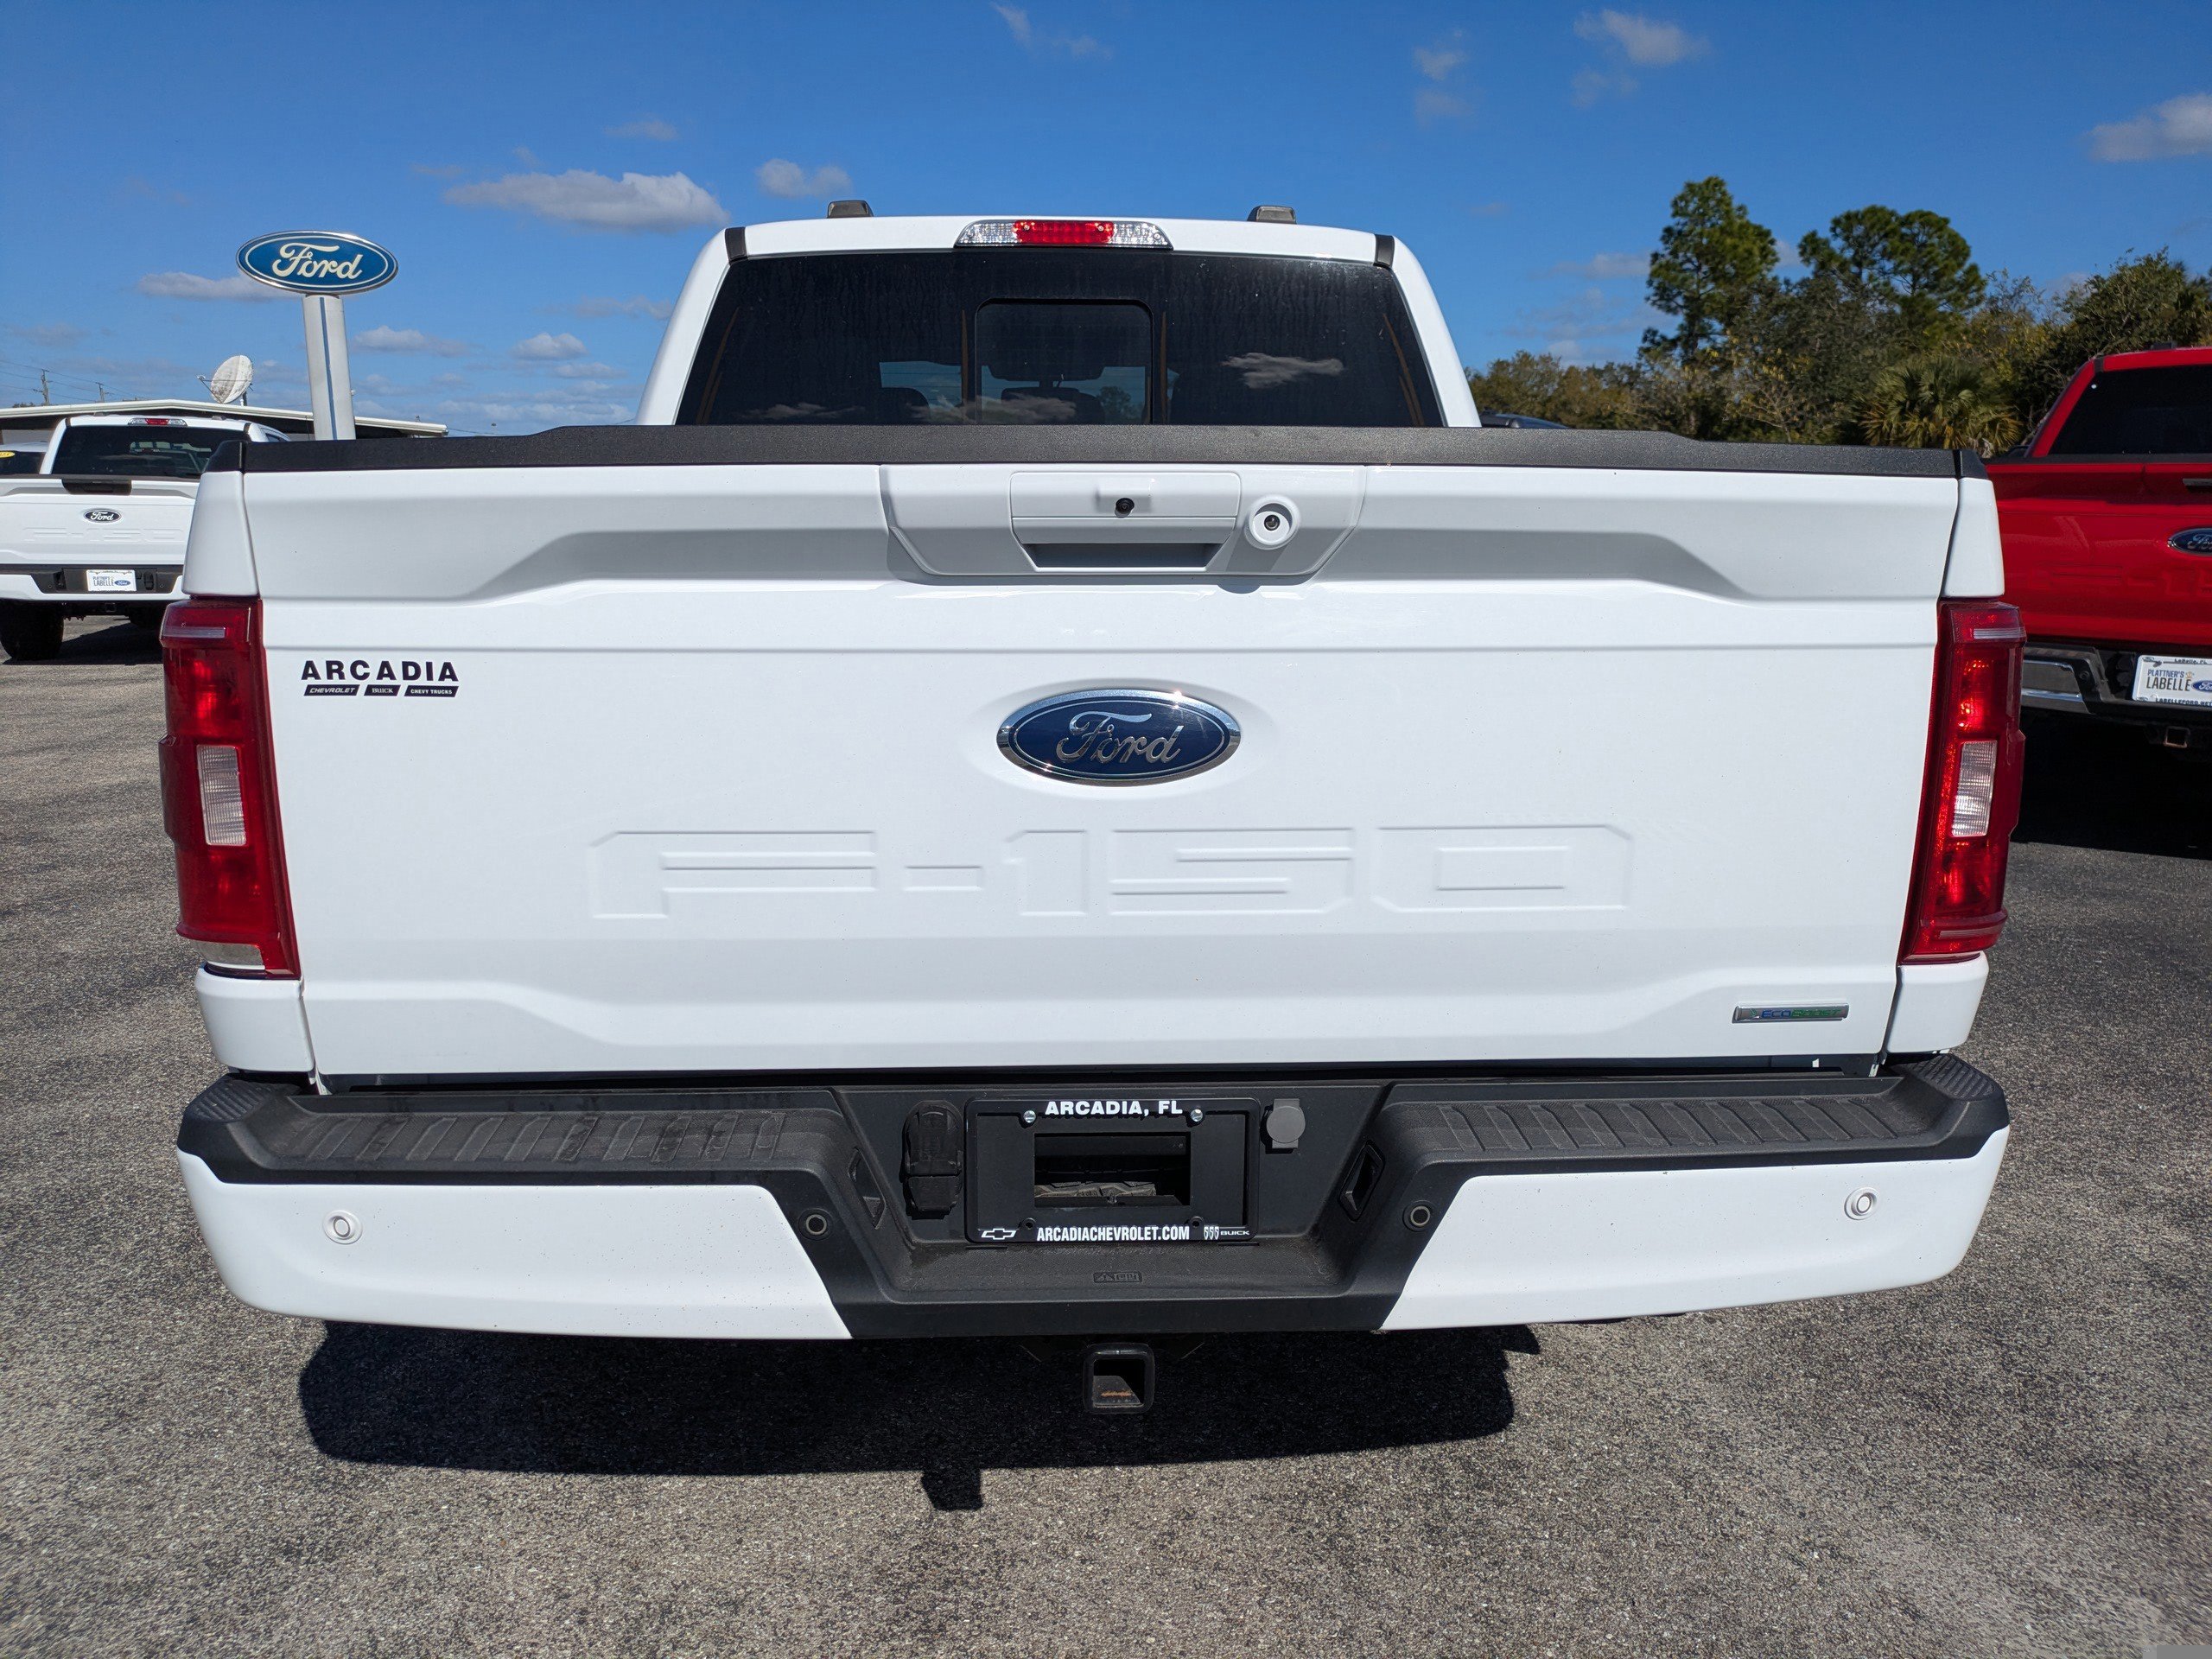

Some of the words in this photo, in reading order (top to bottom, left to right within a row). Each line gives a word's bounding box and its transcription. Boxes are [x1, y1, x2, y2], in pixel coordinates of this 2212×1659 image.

[272, 242, 364, 280] Ford
[90, 511, 114, 521] Ford
[2187, 533, 2212, 550] Fo
[301, 659, 459, 682] ARCADIA
[2147, 669, 2185, 678] PLATTNER'S
[2145, 677, 2192, 691] LABELLE
[1056, 710, 1185, 764] Ford
[589, 824, 1633, 919] F-150
[1045, 1100, 1150, 1117] ARCADIA,
[1158, 1100, 1183, 1115] FL
[1036, 1225, 1190, 1242] ARCADIACHEVROLET.COM
